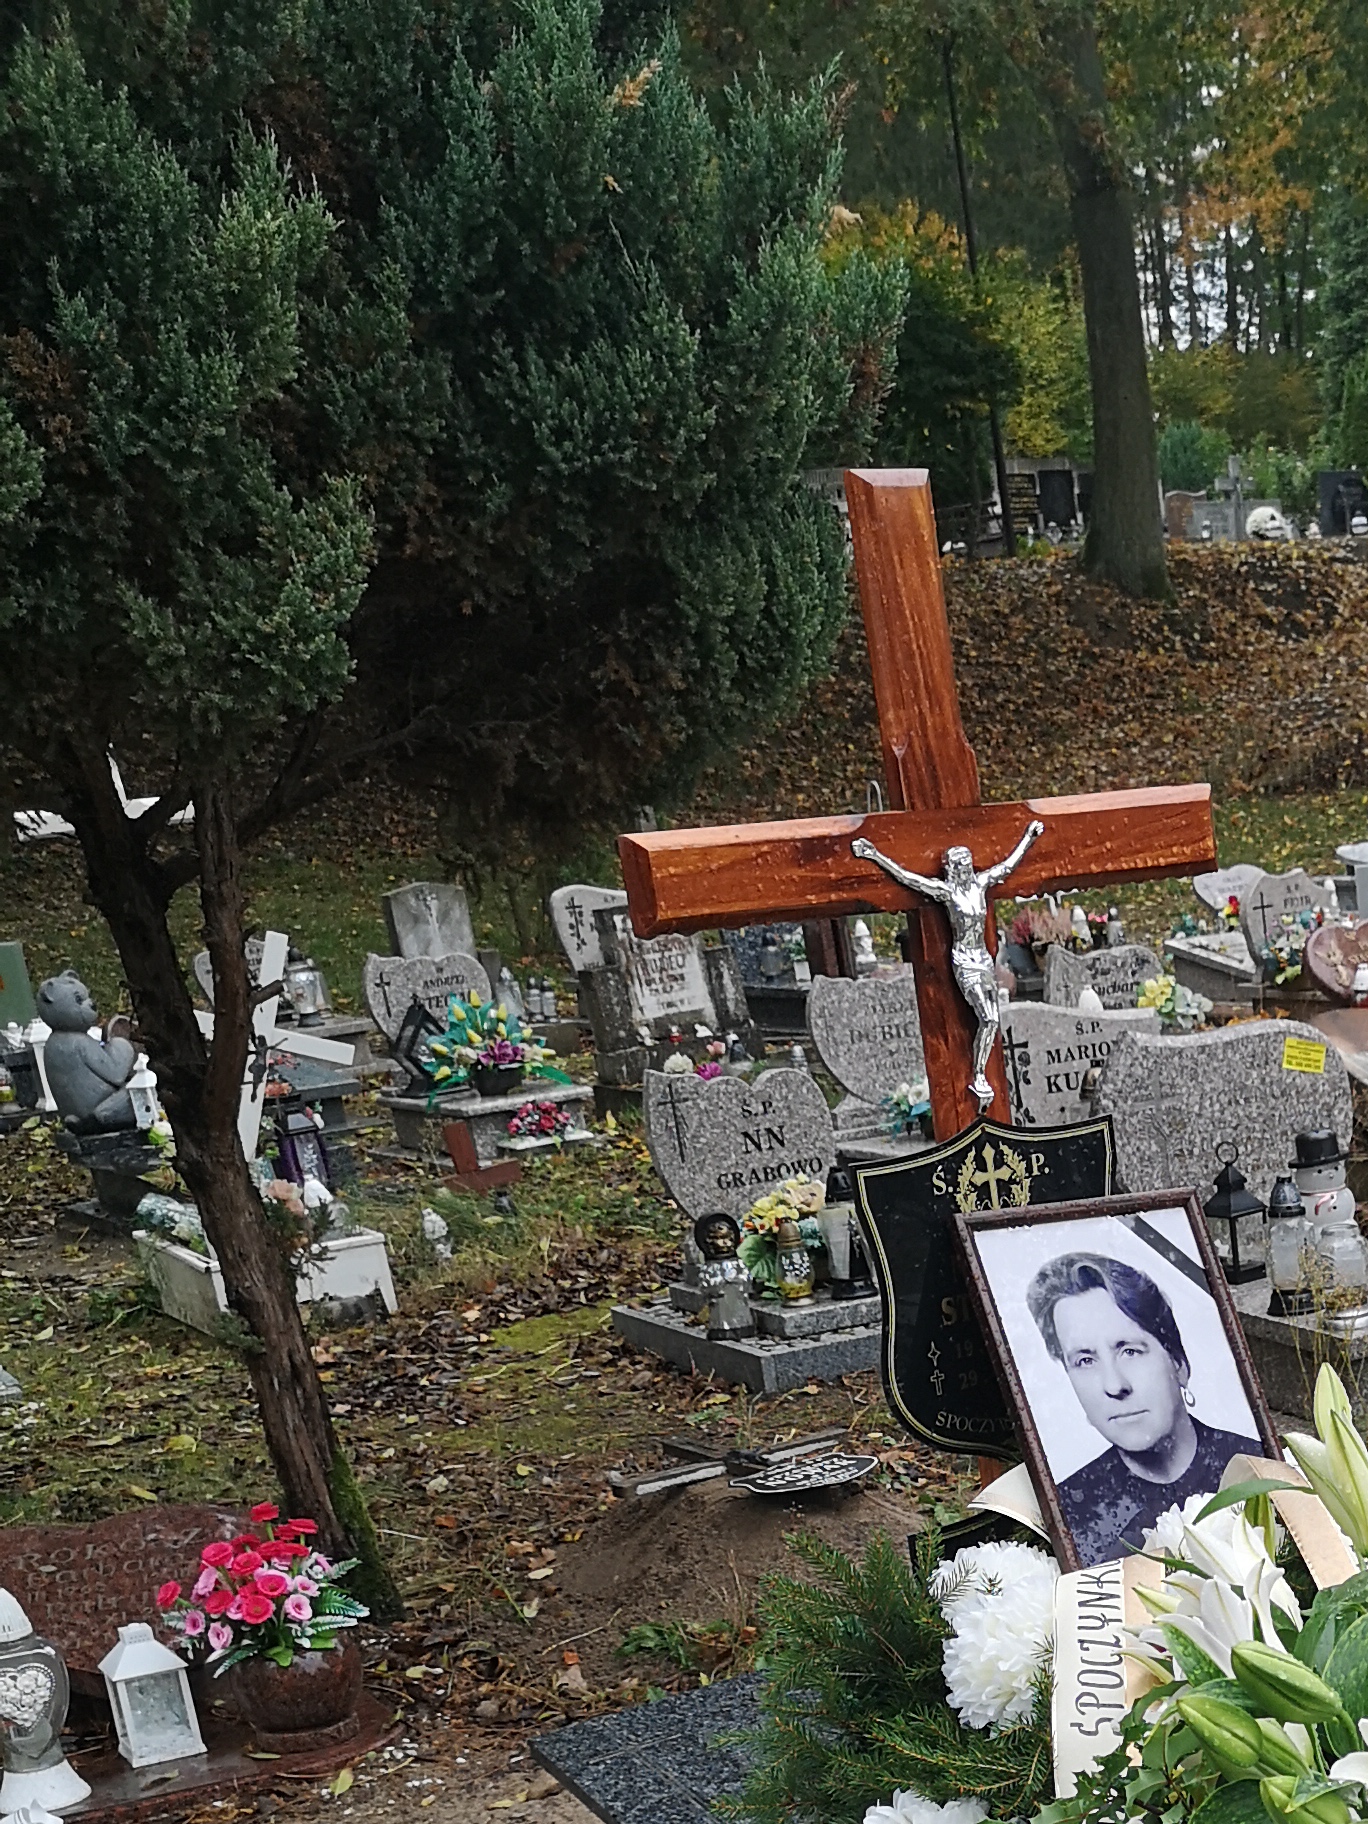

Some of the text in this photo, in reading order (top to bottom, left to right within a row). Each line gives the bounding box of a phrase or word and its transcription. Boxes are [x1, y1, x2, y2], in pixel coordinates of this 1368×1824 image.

[1046, 1040, 1117, 1066] MARIO
[741, 1125, 786, 1154] NN
[717, 1156, 823, 1190] GRABOWO
